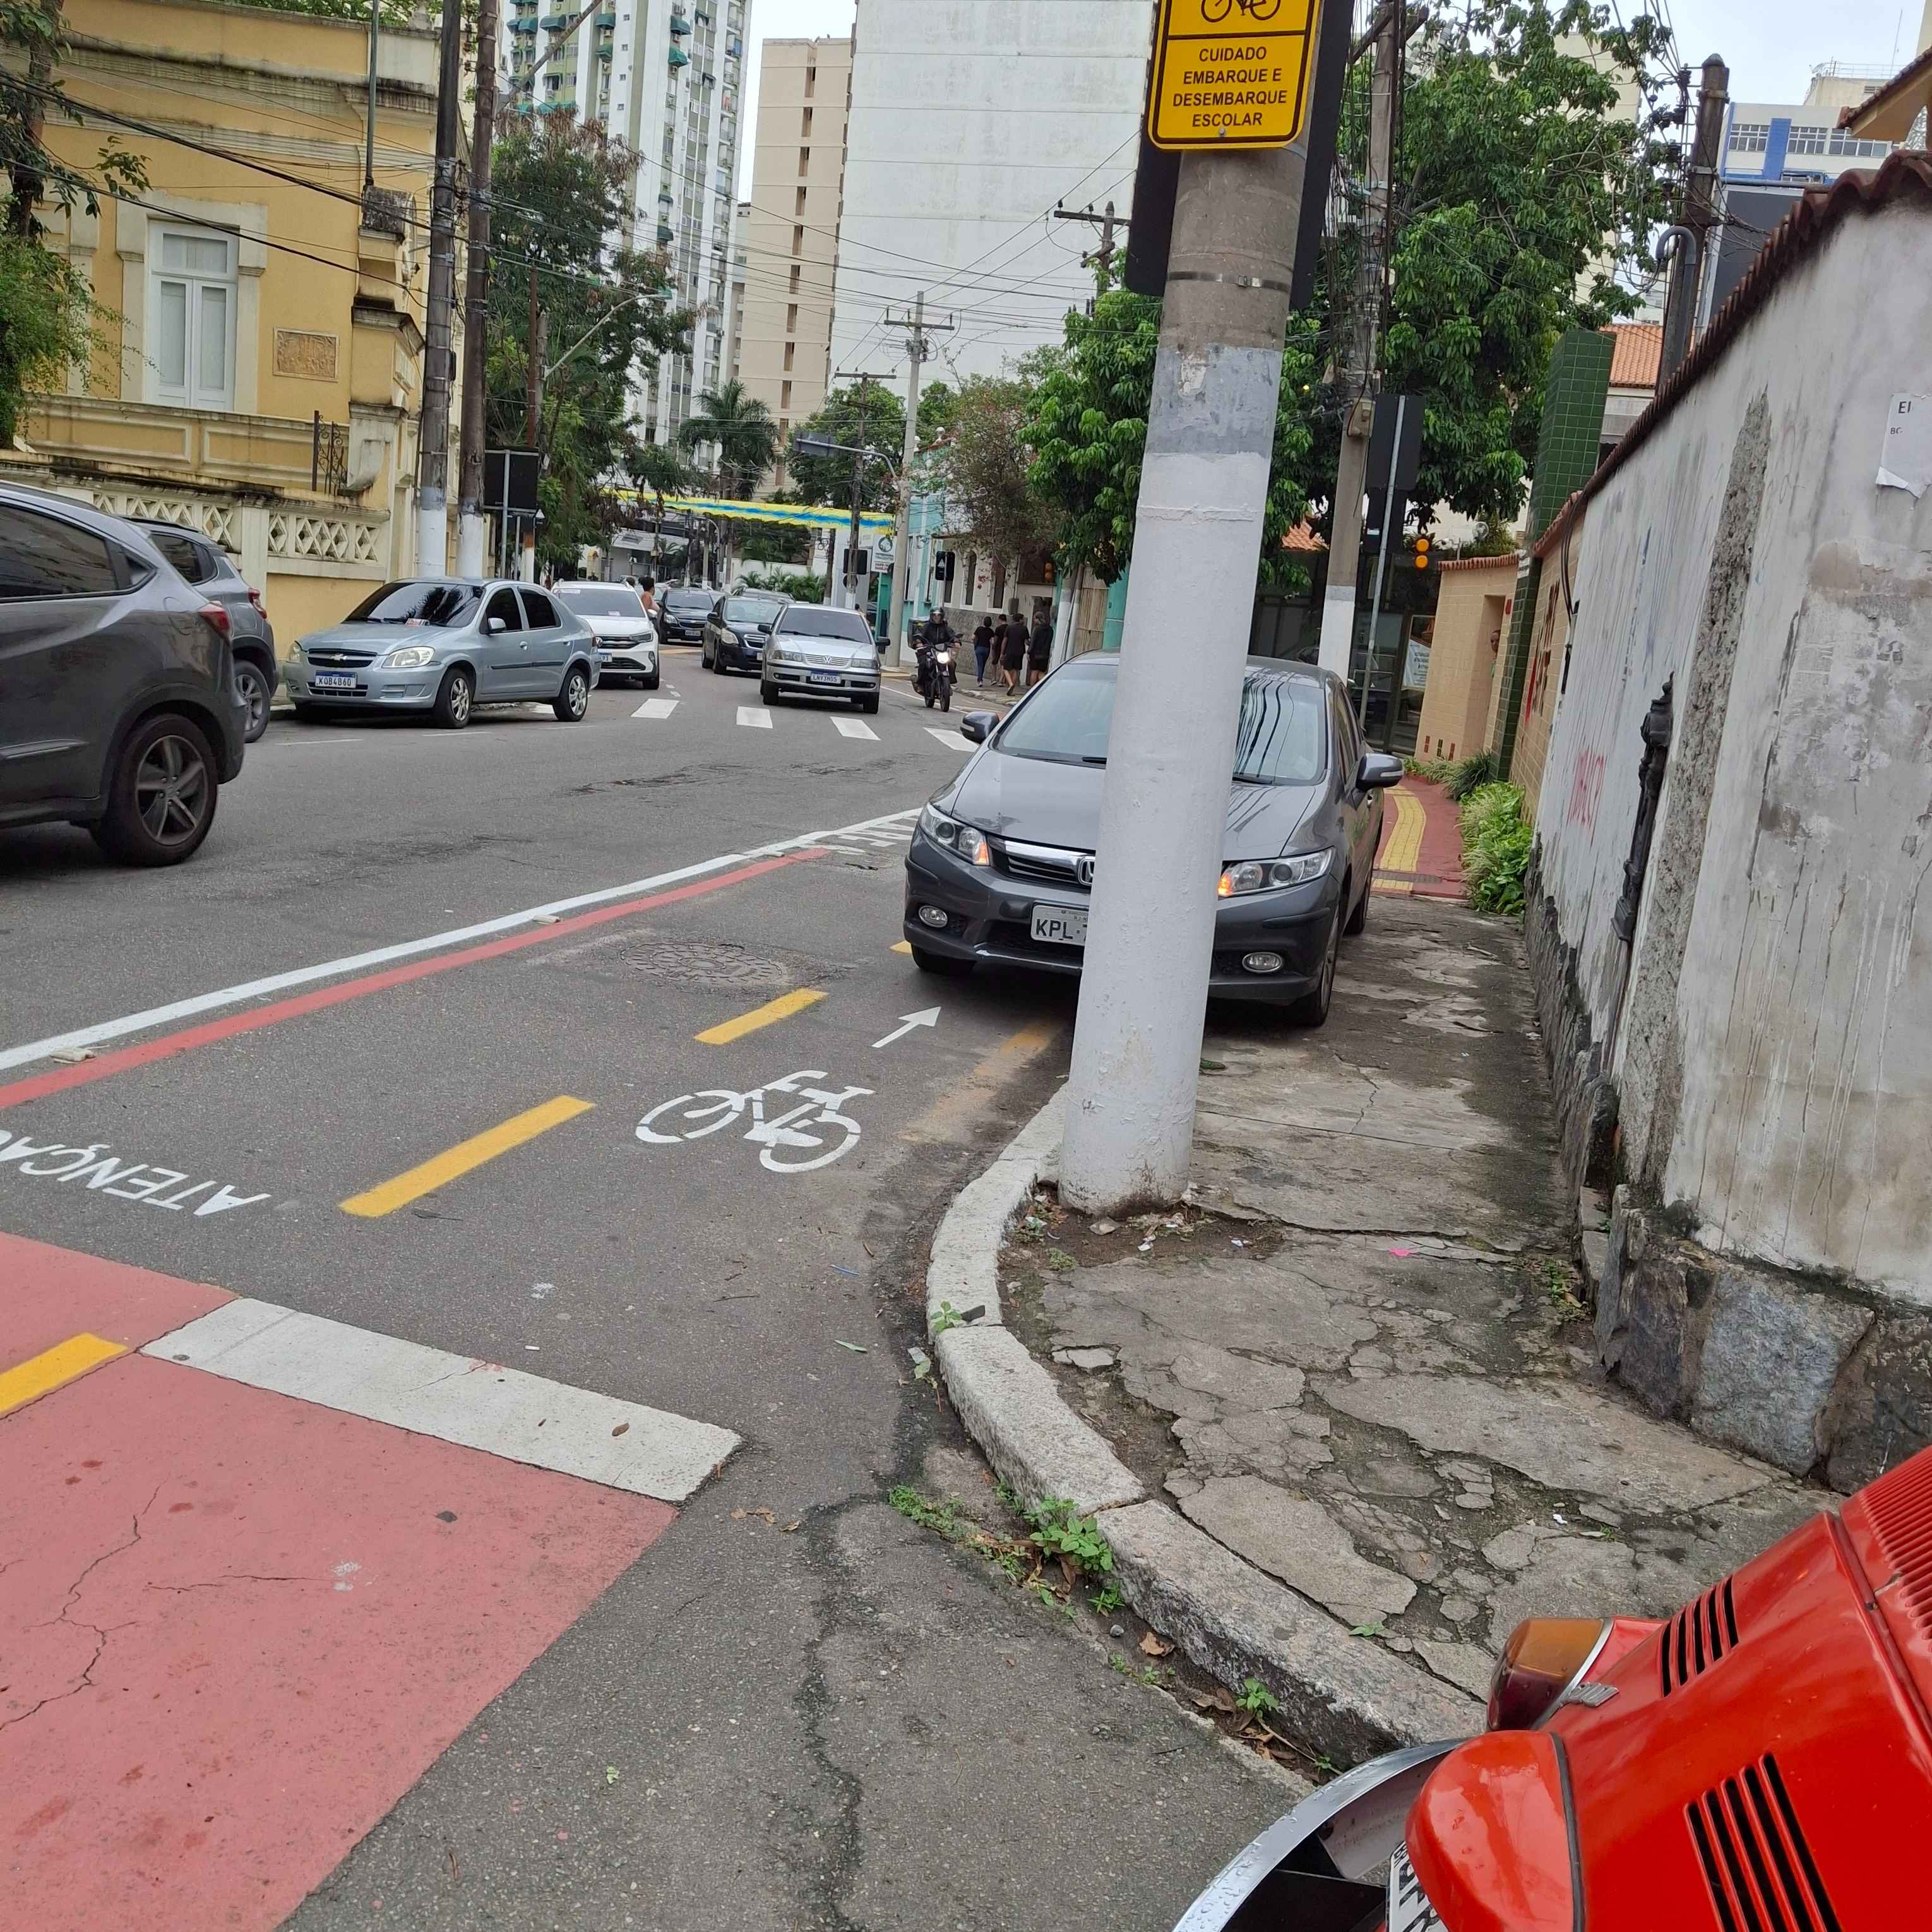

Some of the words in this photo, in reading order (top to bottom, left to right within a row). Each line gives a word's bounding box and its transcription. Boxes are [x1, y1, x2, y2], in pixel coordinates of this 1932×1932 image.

[1199, 46, 1267, 62] CUIDADO
[1183, 68, 1268, 85] EMBARQUE
[1272, 68, 1282, 81] E
[1172, 90, 1287, 107] DESEMBARQUE
[1192, 112, 1263, 127] ESCOLAR
